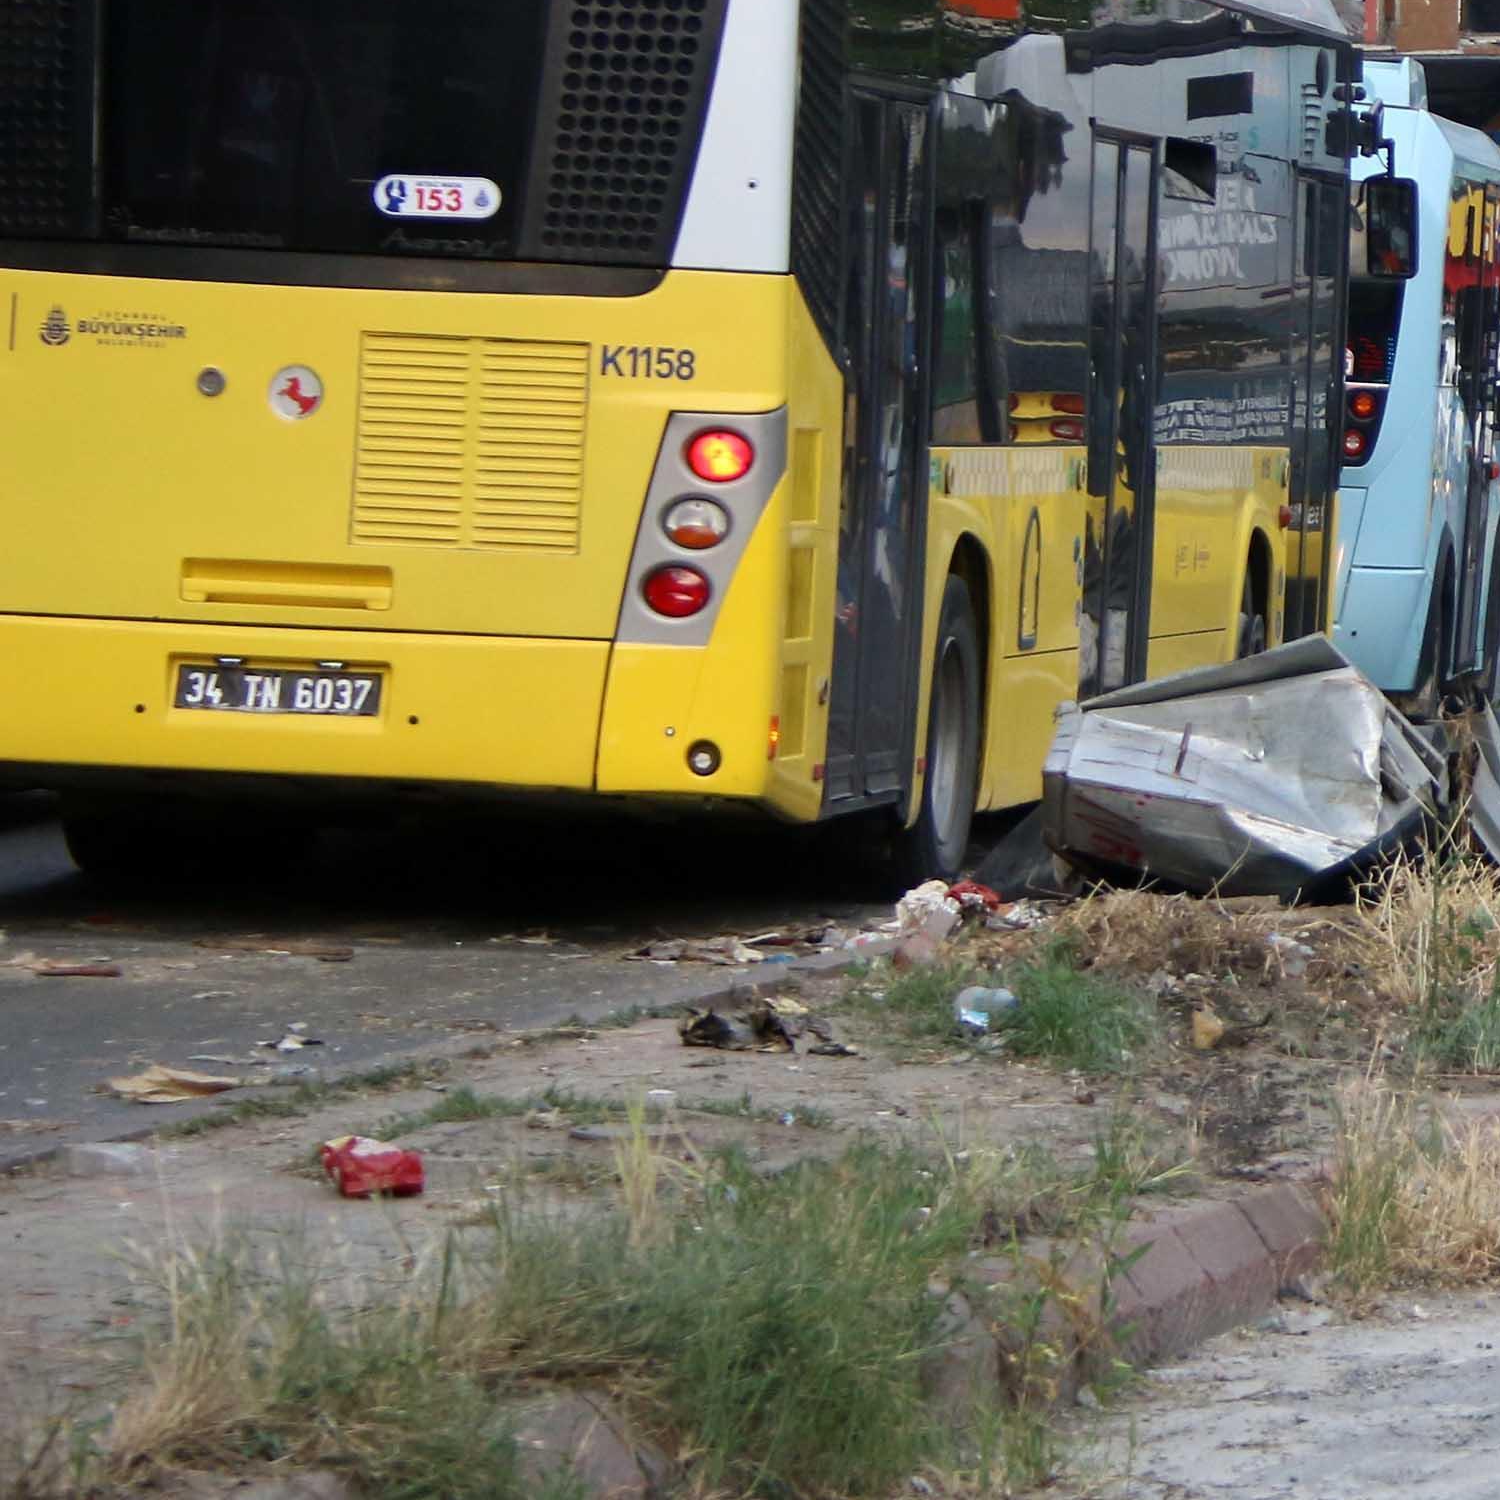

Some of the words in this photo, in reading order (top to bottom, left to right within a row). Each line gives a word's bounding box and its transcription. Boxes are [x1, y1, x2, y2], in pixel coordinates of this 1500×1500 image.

[415, 187, 463, 212] 153
[600, 344, 695, 381] K1158
[185, 671, 223, 704] 34
[244, 675, 282, 709] TN
[294, 678, 373, 711] 6037
